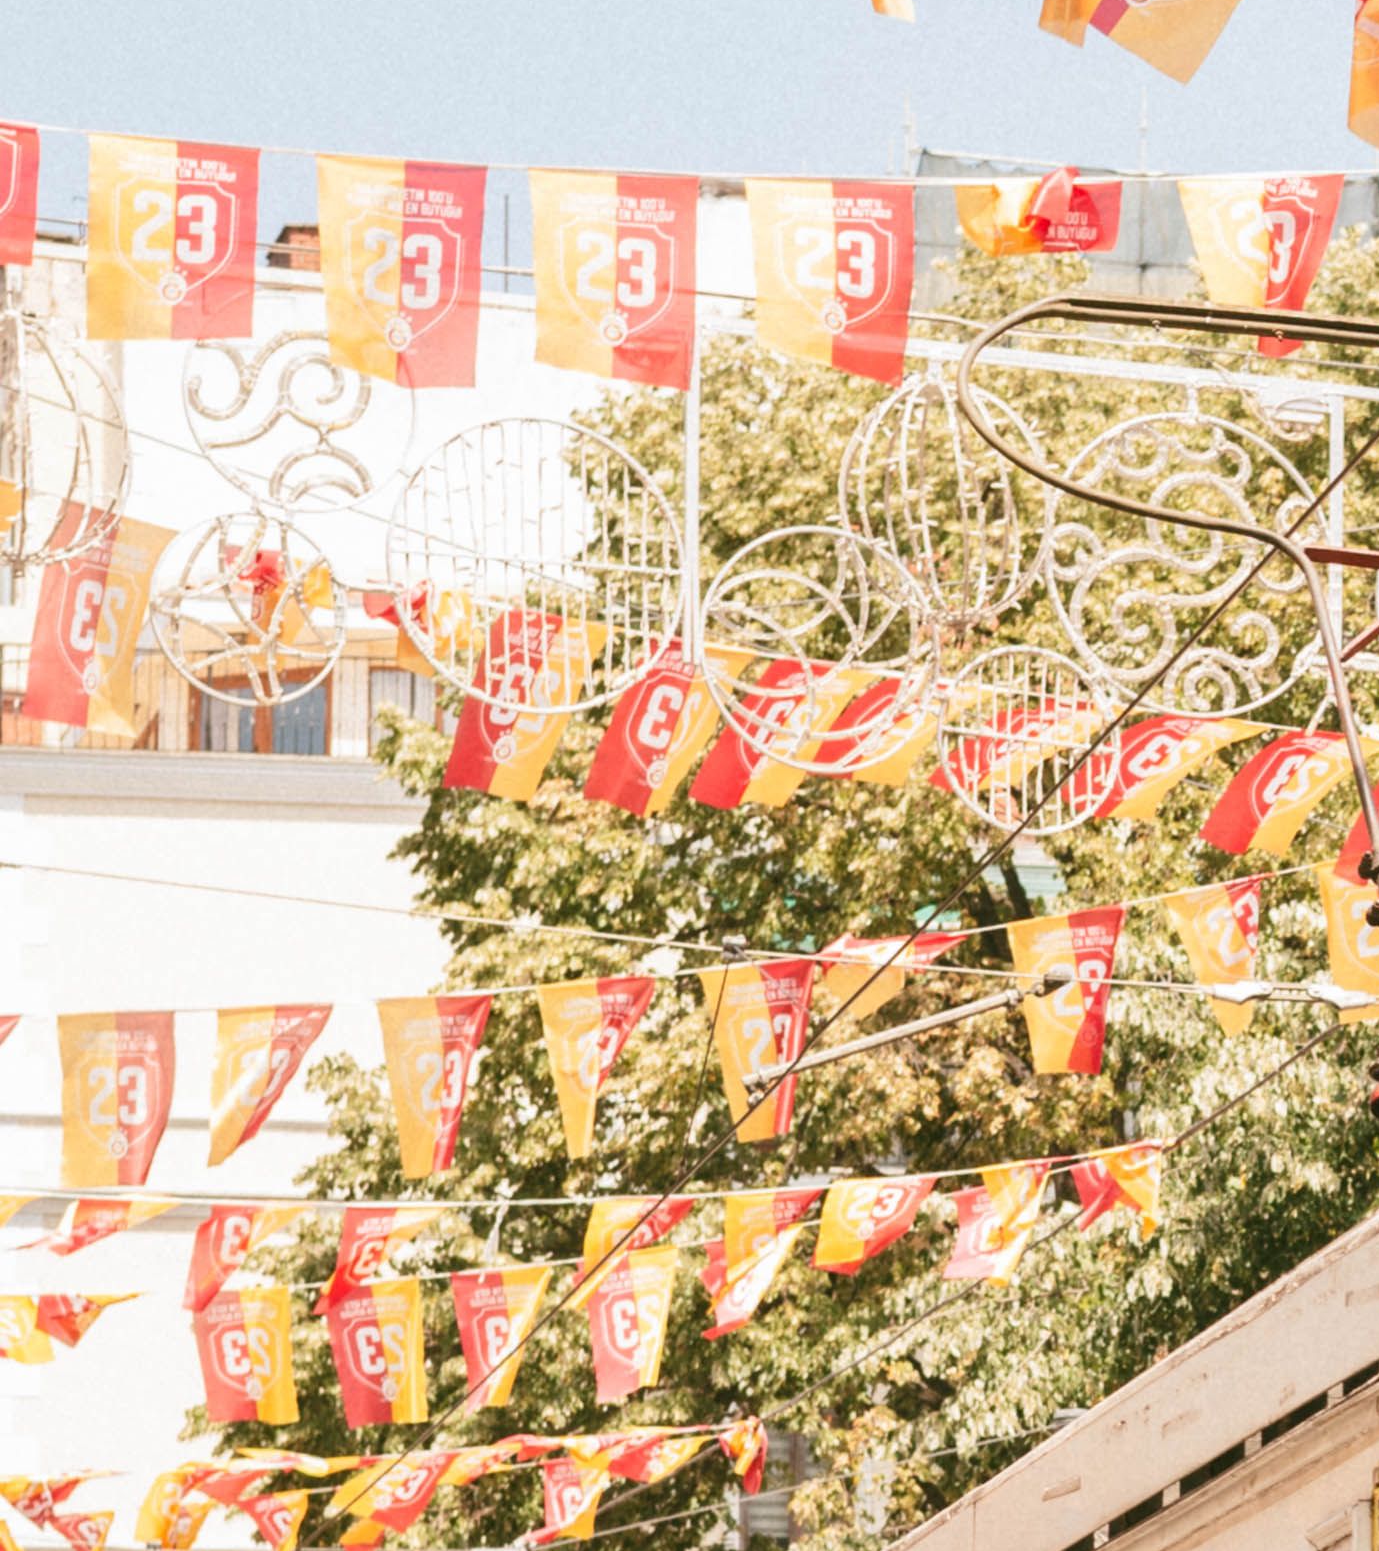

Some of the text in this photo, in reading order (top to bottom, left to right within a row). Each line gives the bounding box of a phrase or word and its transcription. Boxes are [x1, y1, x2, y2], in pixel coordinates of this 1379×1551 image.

[132, 189, 218, 264] 23
[363, 227, 443, 310] 23
[576, 230, 656, 307] 23
[793, 227, 876, 298] 23
[88, 1065, 148, 1126] 23
[417, 1050, 464, 1111] 23
[848, 1185, 904, 1221] 23
